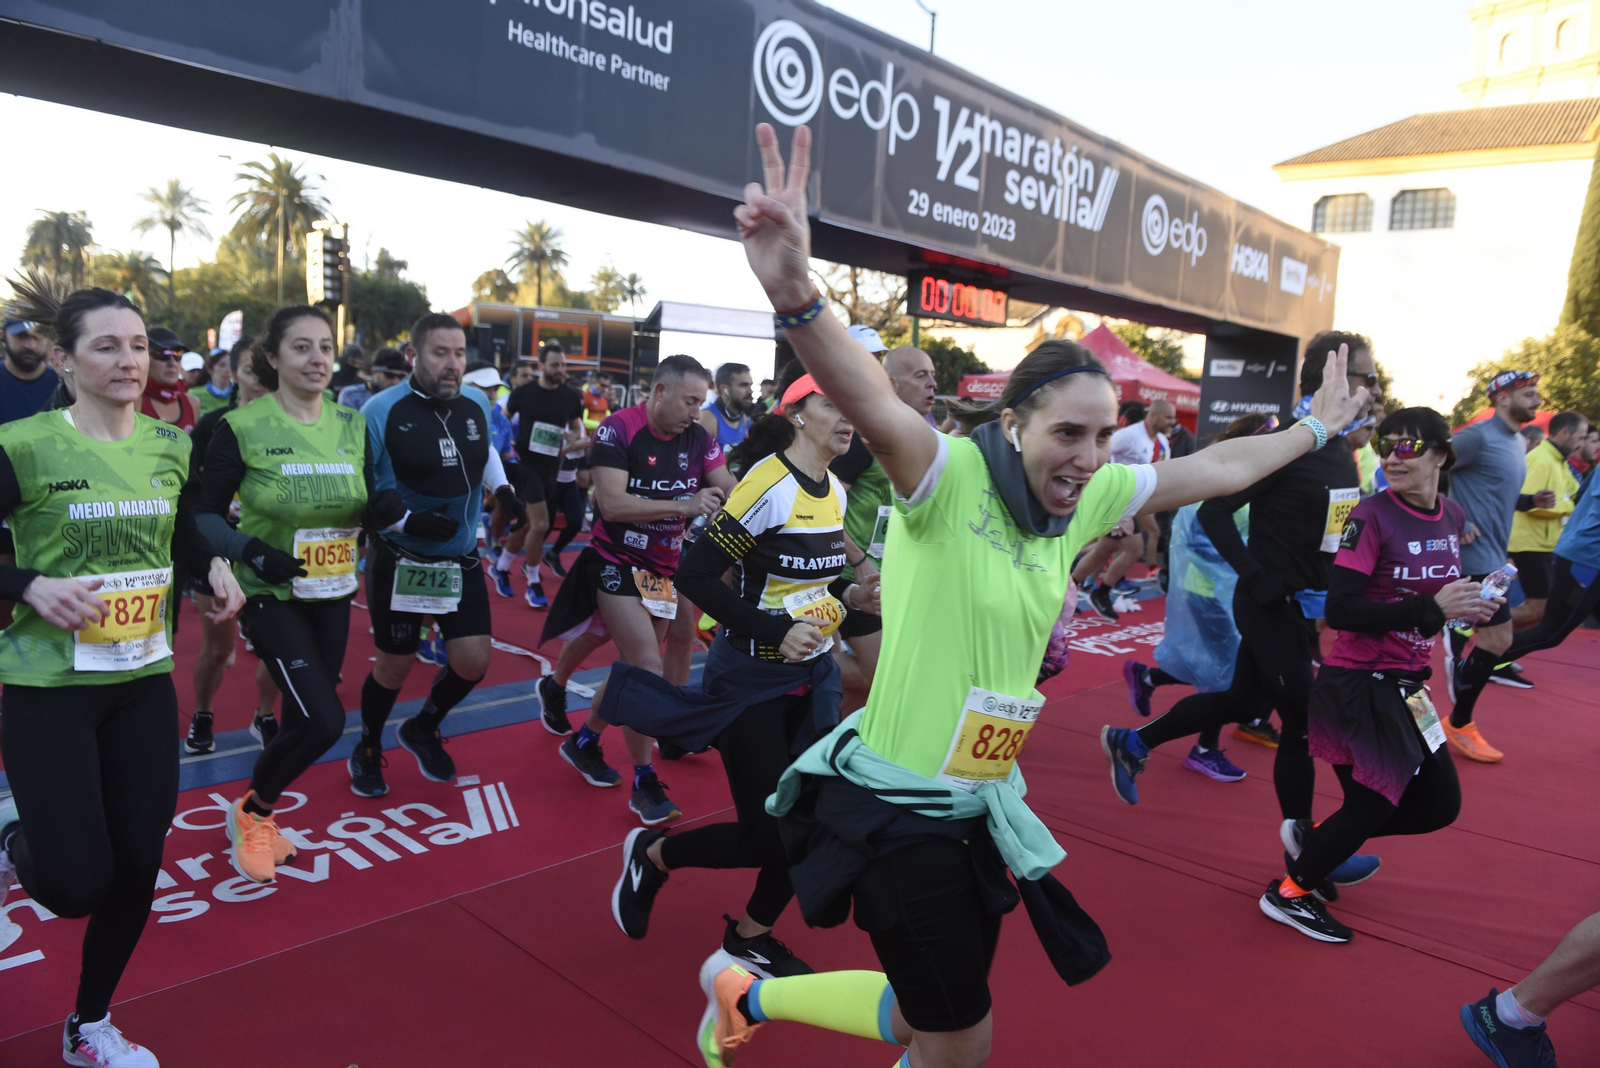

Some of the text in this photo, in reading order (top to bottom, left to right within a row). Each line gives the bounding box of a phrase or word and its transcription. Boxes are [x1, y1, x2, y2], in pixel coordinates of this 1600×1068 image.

[508, 19, 670, 92] Healthcare Partner
[828, 62, 920, 156] edp
[973, 111, 1095, 193] maratón
[907, 188, 1016, 242] 29 enero 2023
[1168, 210, 1208, 267] edp
[1230, 242, 1269, 283] HOKA
[1229, 402, 1280, 414] HYUNDAI
[155, 426, 178, 440] 2023
[265, 447, 294, 457] HOKA
[281, 460, 355, 476] MEDIO MARATÓN
[48, 478, 90, 494] HOKA
[161, 478, 176, 489] edp
[629, 477, 698, 491] ILICAR
[68, 496, 172, 521] MEDIO MARATÓN
[625, 536, 646, 547] CRC
[302, 541, 351, 568] 10526
[406, 569, 448, 589] 7212
[971, 723, 1028, 762] 828
[1479, 1005, 1497, 1034] HOKA
